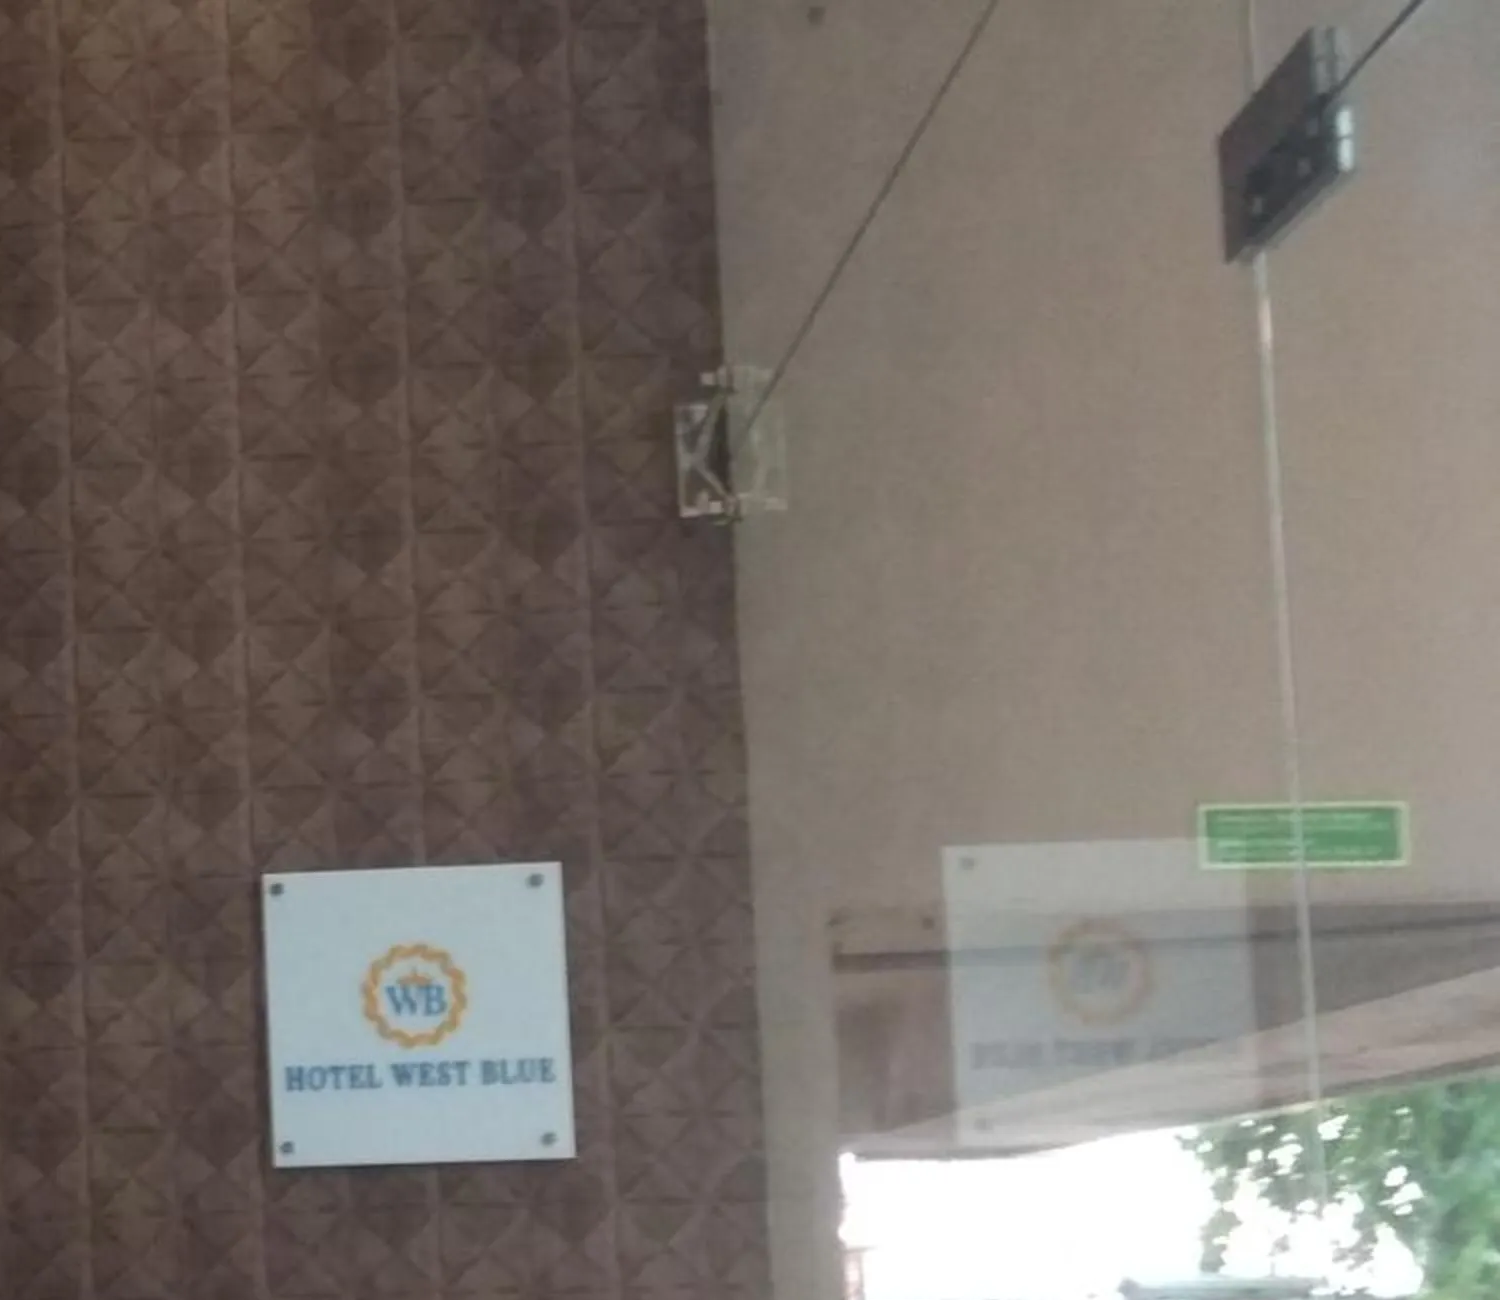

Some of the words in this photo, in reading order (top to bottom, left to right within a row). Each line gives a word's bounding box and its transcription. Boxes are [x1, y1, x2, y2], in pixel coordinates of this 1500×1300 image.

[385, 984, 449, 1017] WB
[285, 1065, 382, 1092] HOTEL
[391, 1061, 471, 1087] WEST
[481, 1057, 556, 1086] BLUE
